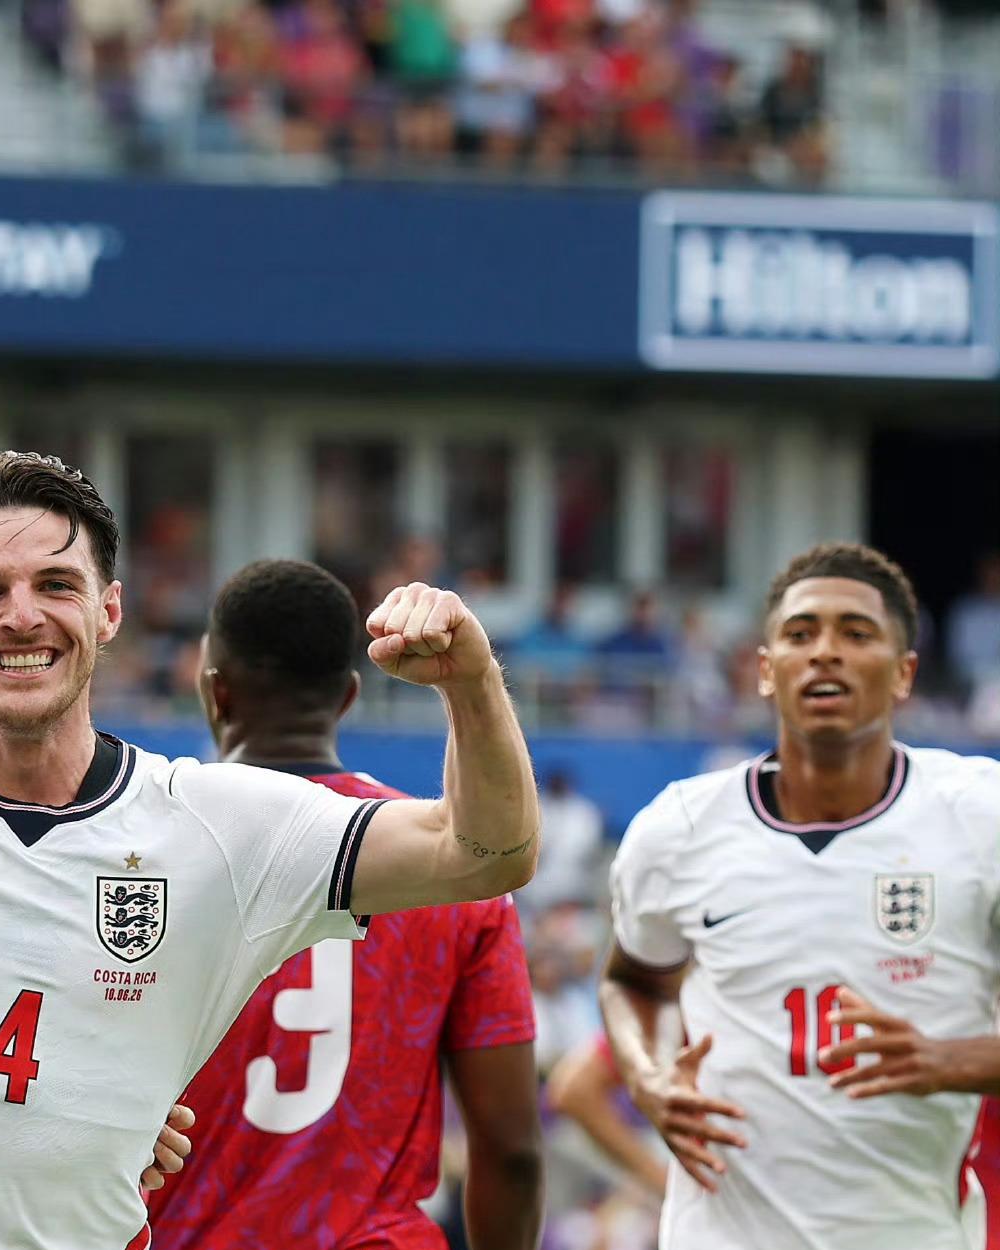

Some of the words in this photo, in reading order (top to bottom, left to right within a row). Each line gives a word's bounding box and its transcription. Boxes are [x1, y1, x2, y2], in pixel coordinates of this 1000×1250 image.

[676, 228, 969, 341] Hilton
[93, 968, 131, 985] COSTA
[133, 971, 157, 985] RICA
[104, 987, 143, 1002] 10.06.26
[243, 938, 352, 1134] 3
[783, 983, 856, 1078] 10
